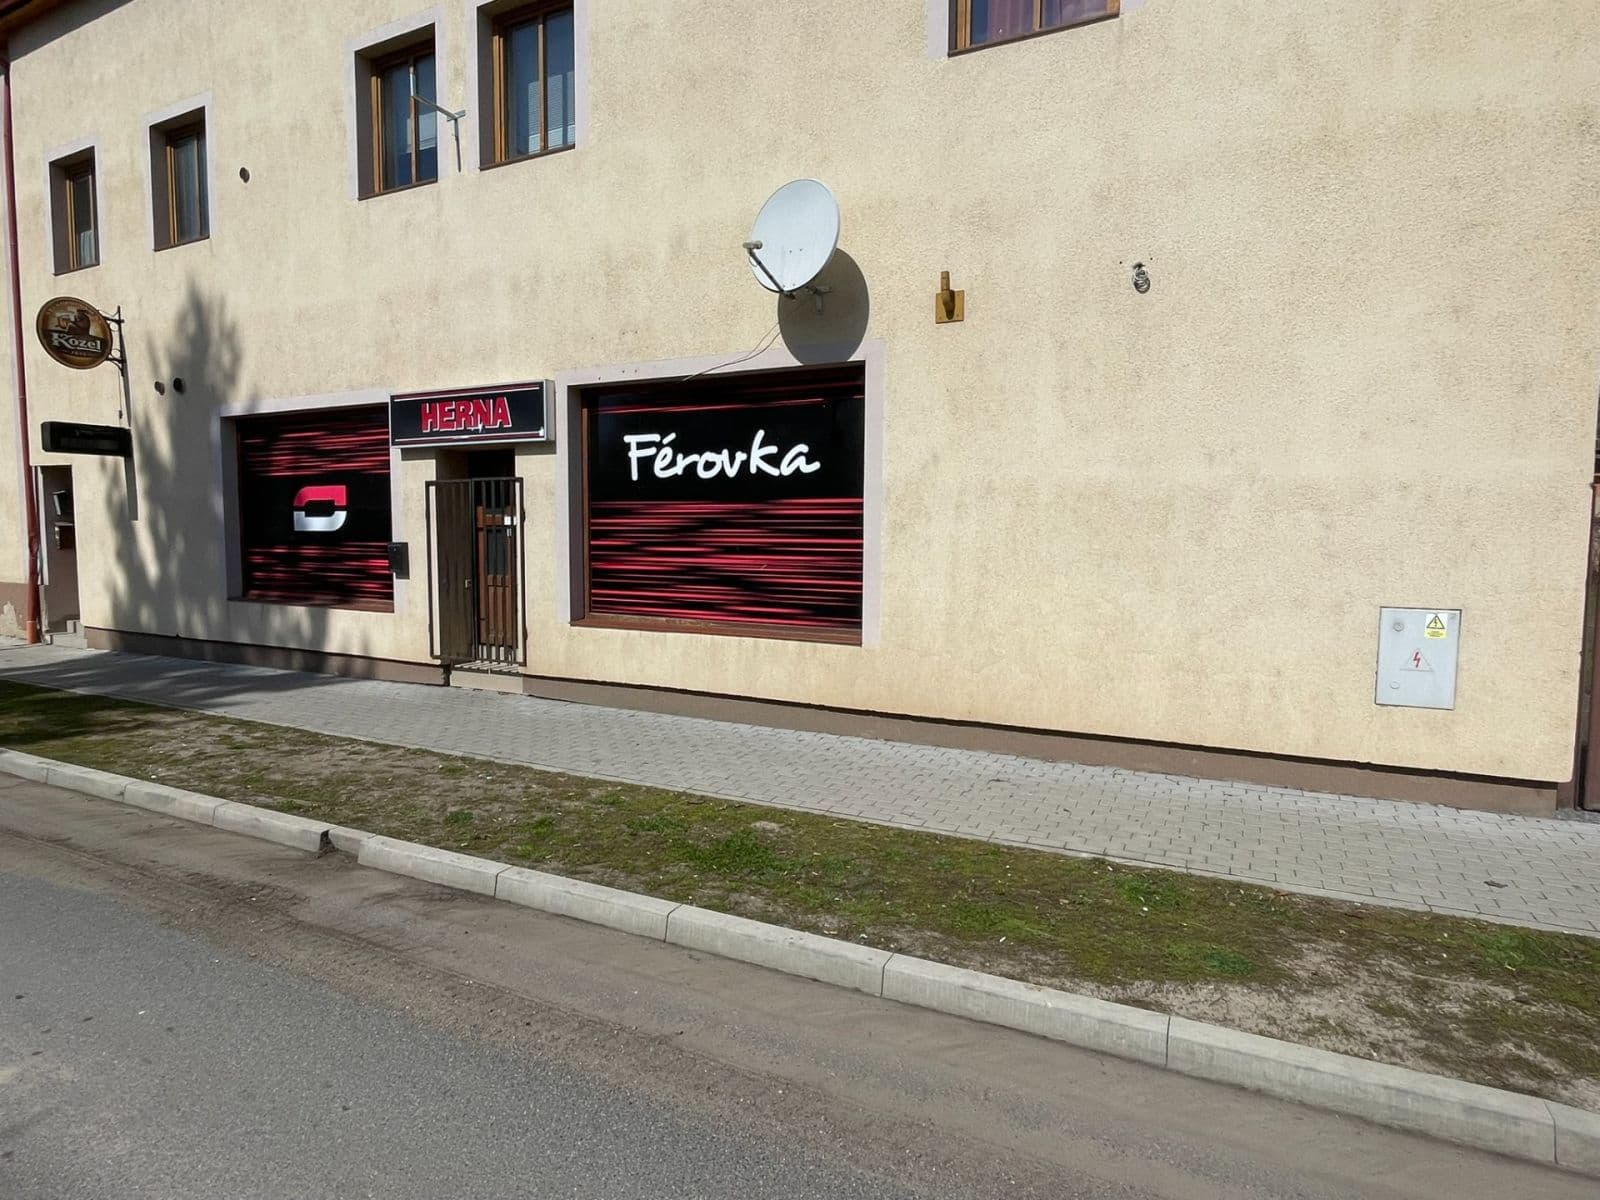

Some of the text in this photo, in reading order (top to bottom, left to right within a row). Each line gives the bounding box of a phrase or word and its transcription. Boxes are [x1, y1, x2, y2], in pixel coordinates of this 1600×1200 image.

[52, 333, 101, 352] Kozel
[420, 397, 512, 432] HERNA
[623, 429, 821, 481] Férovka
